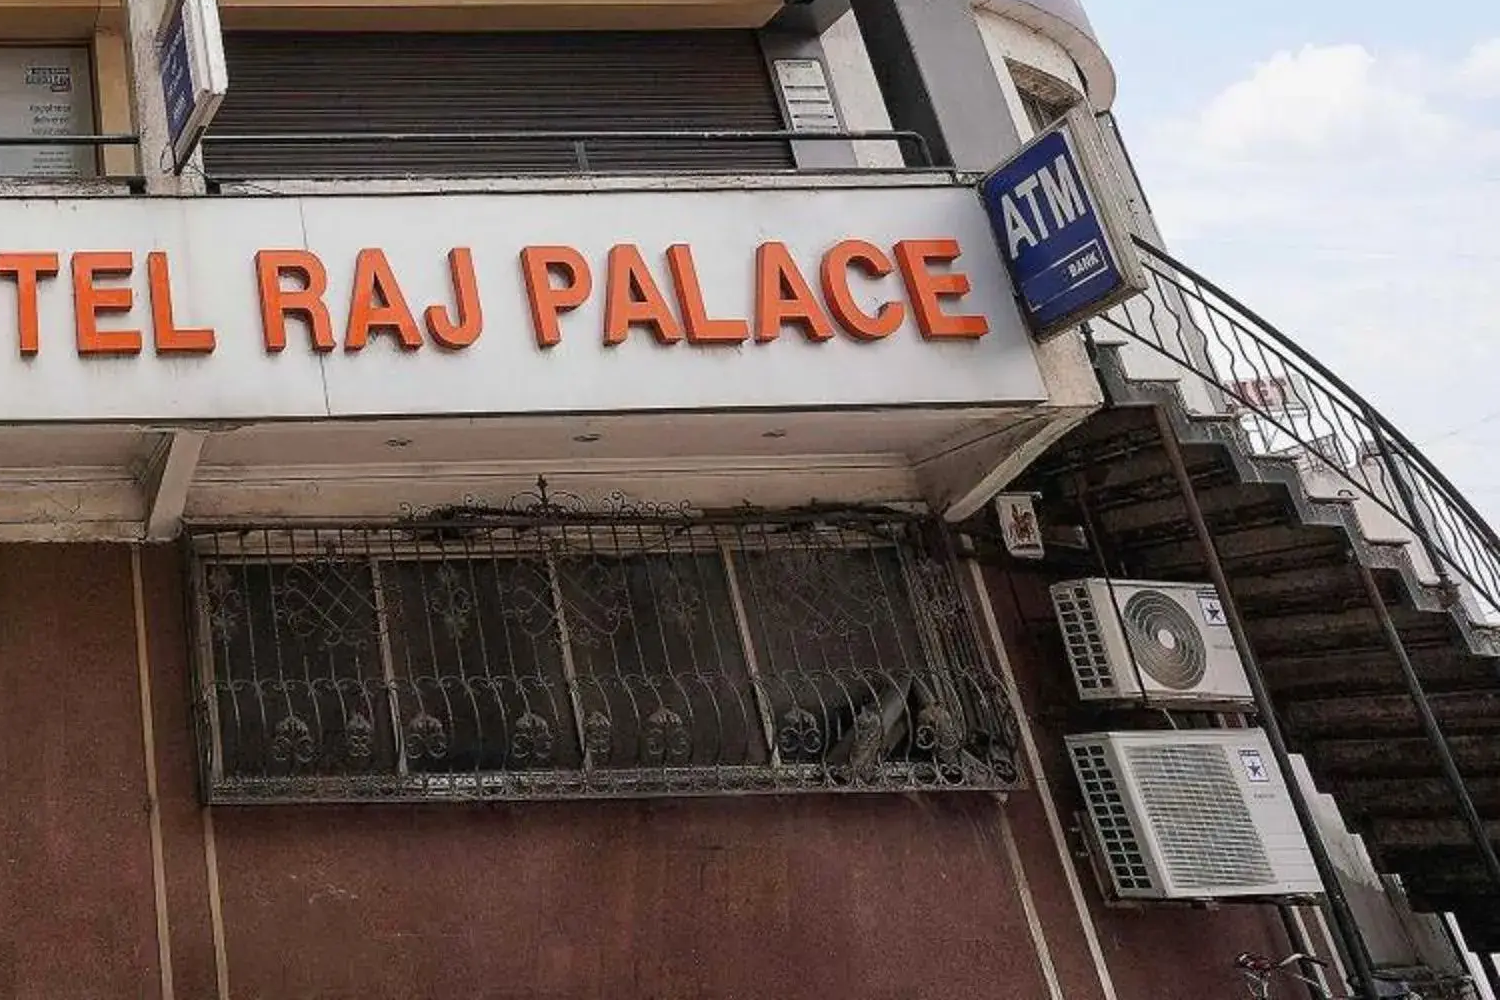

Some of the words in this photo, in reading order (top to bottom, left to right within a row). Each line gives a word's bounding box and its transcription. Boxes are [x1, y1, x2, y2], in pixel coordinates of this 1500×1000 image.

[1001, 154, 1087, 260] ATM
[255, 246, 484, 354] RAJ
[519, 238, 990, 350] PALACE
[1067, 251, 1100, 278] BANK
